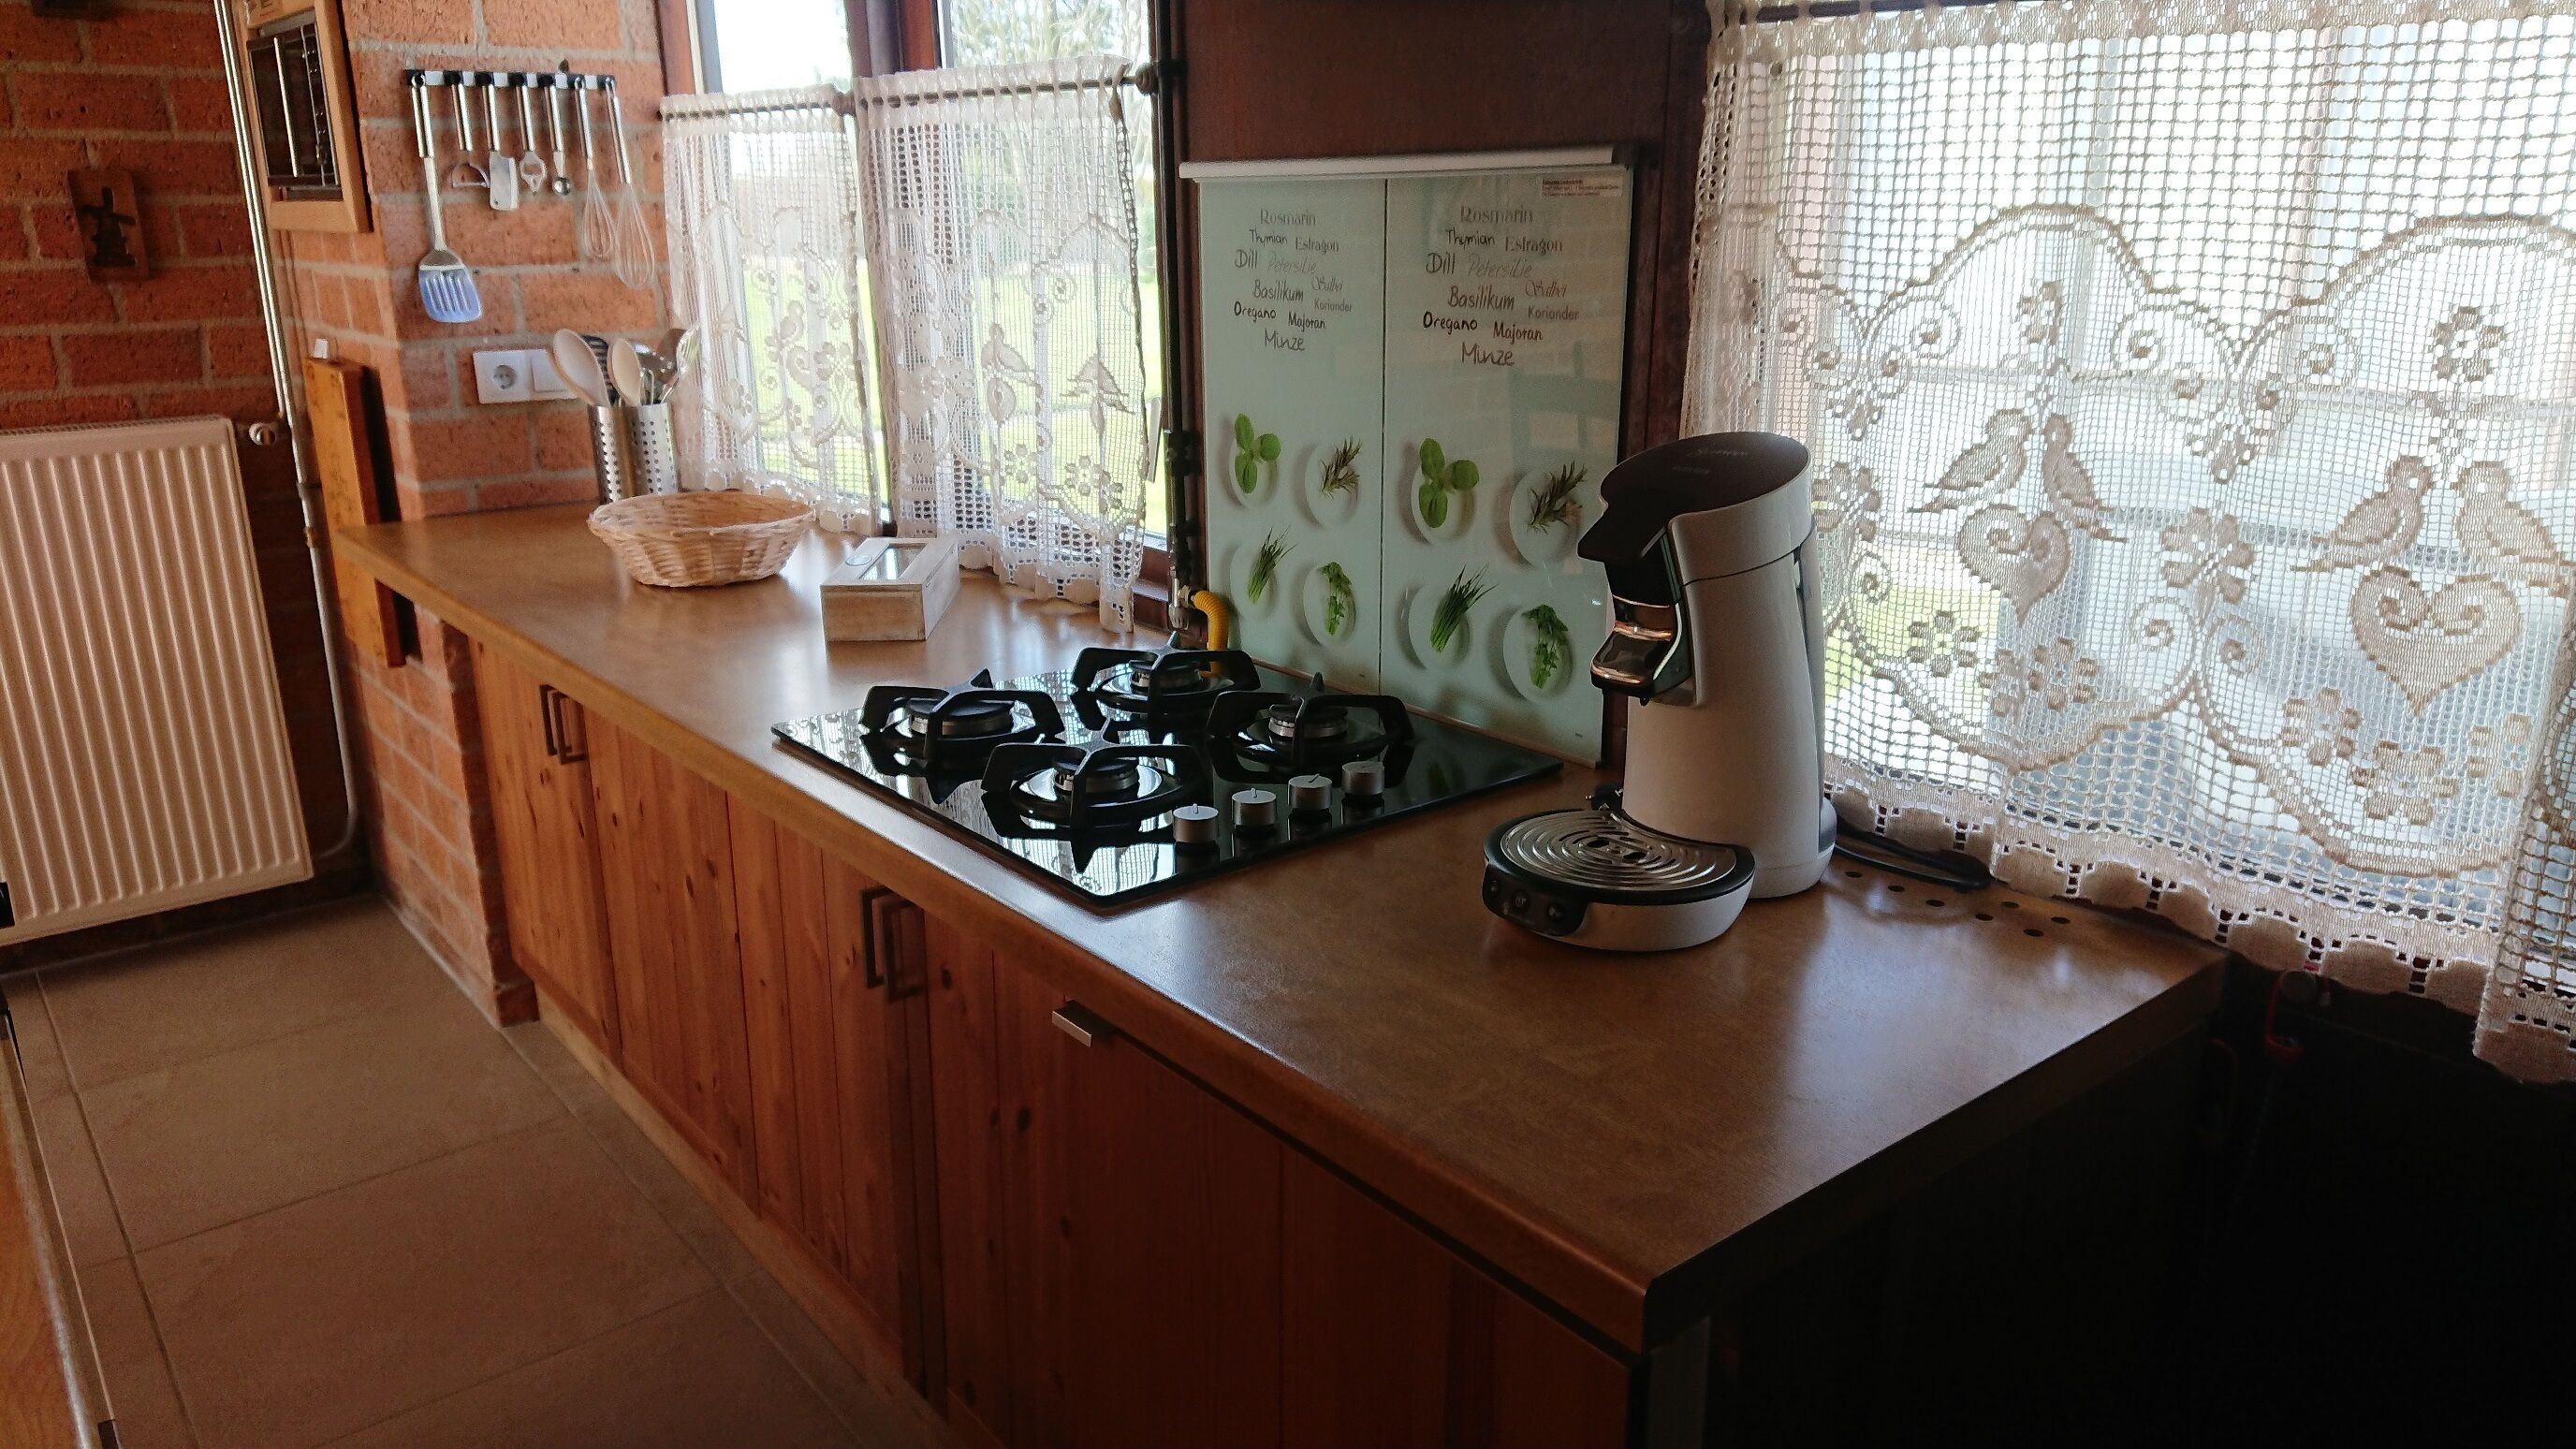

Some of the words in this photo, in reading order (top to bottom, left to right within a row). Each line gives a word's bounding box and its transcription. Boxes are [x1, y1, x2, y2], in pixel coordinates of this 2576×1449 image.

[1260, 209, 1316, 226] Rosmarin
[1461, 205, 1533, 224] Rosmarin
[1250, 227, 1287, 247] Thymian
[1295, 237, 1339, 255] Estragon
[1445, 227, 1496, 249] Thymian
[1505, 236, 1563, 256] Estragon
[1235, 249, 1257, 269] Dill
[1266, 250, 1317, 275] Petersilie
[1426, 252, 1456, 274] Dill
[1468, 254, 1533, 277] Petersilie
[1252, 279, 1304, 302] Basilikum
[1447, 285, 1515, 311] Basilikum
[1234, 301, 1276, 322] Oregano
[1288, 312, 1325, 332] Majoran
[1314, 299, 1354, 313] Koriander
[1529, 305, 1579, 321] Koriander
[1423, 311, 1478, 335] Oregano
[1493, 321, 1543, 344] Majoran
[1265, 329, 1305, 351] Minze
[1462, 342, 1515, 366] Minze
